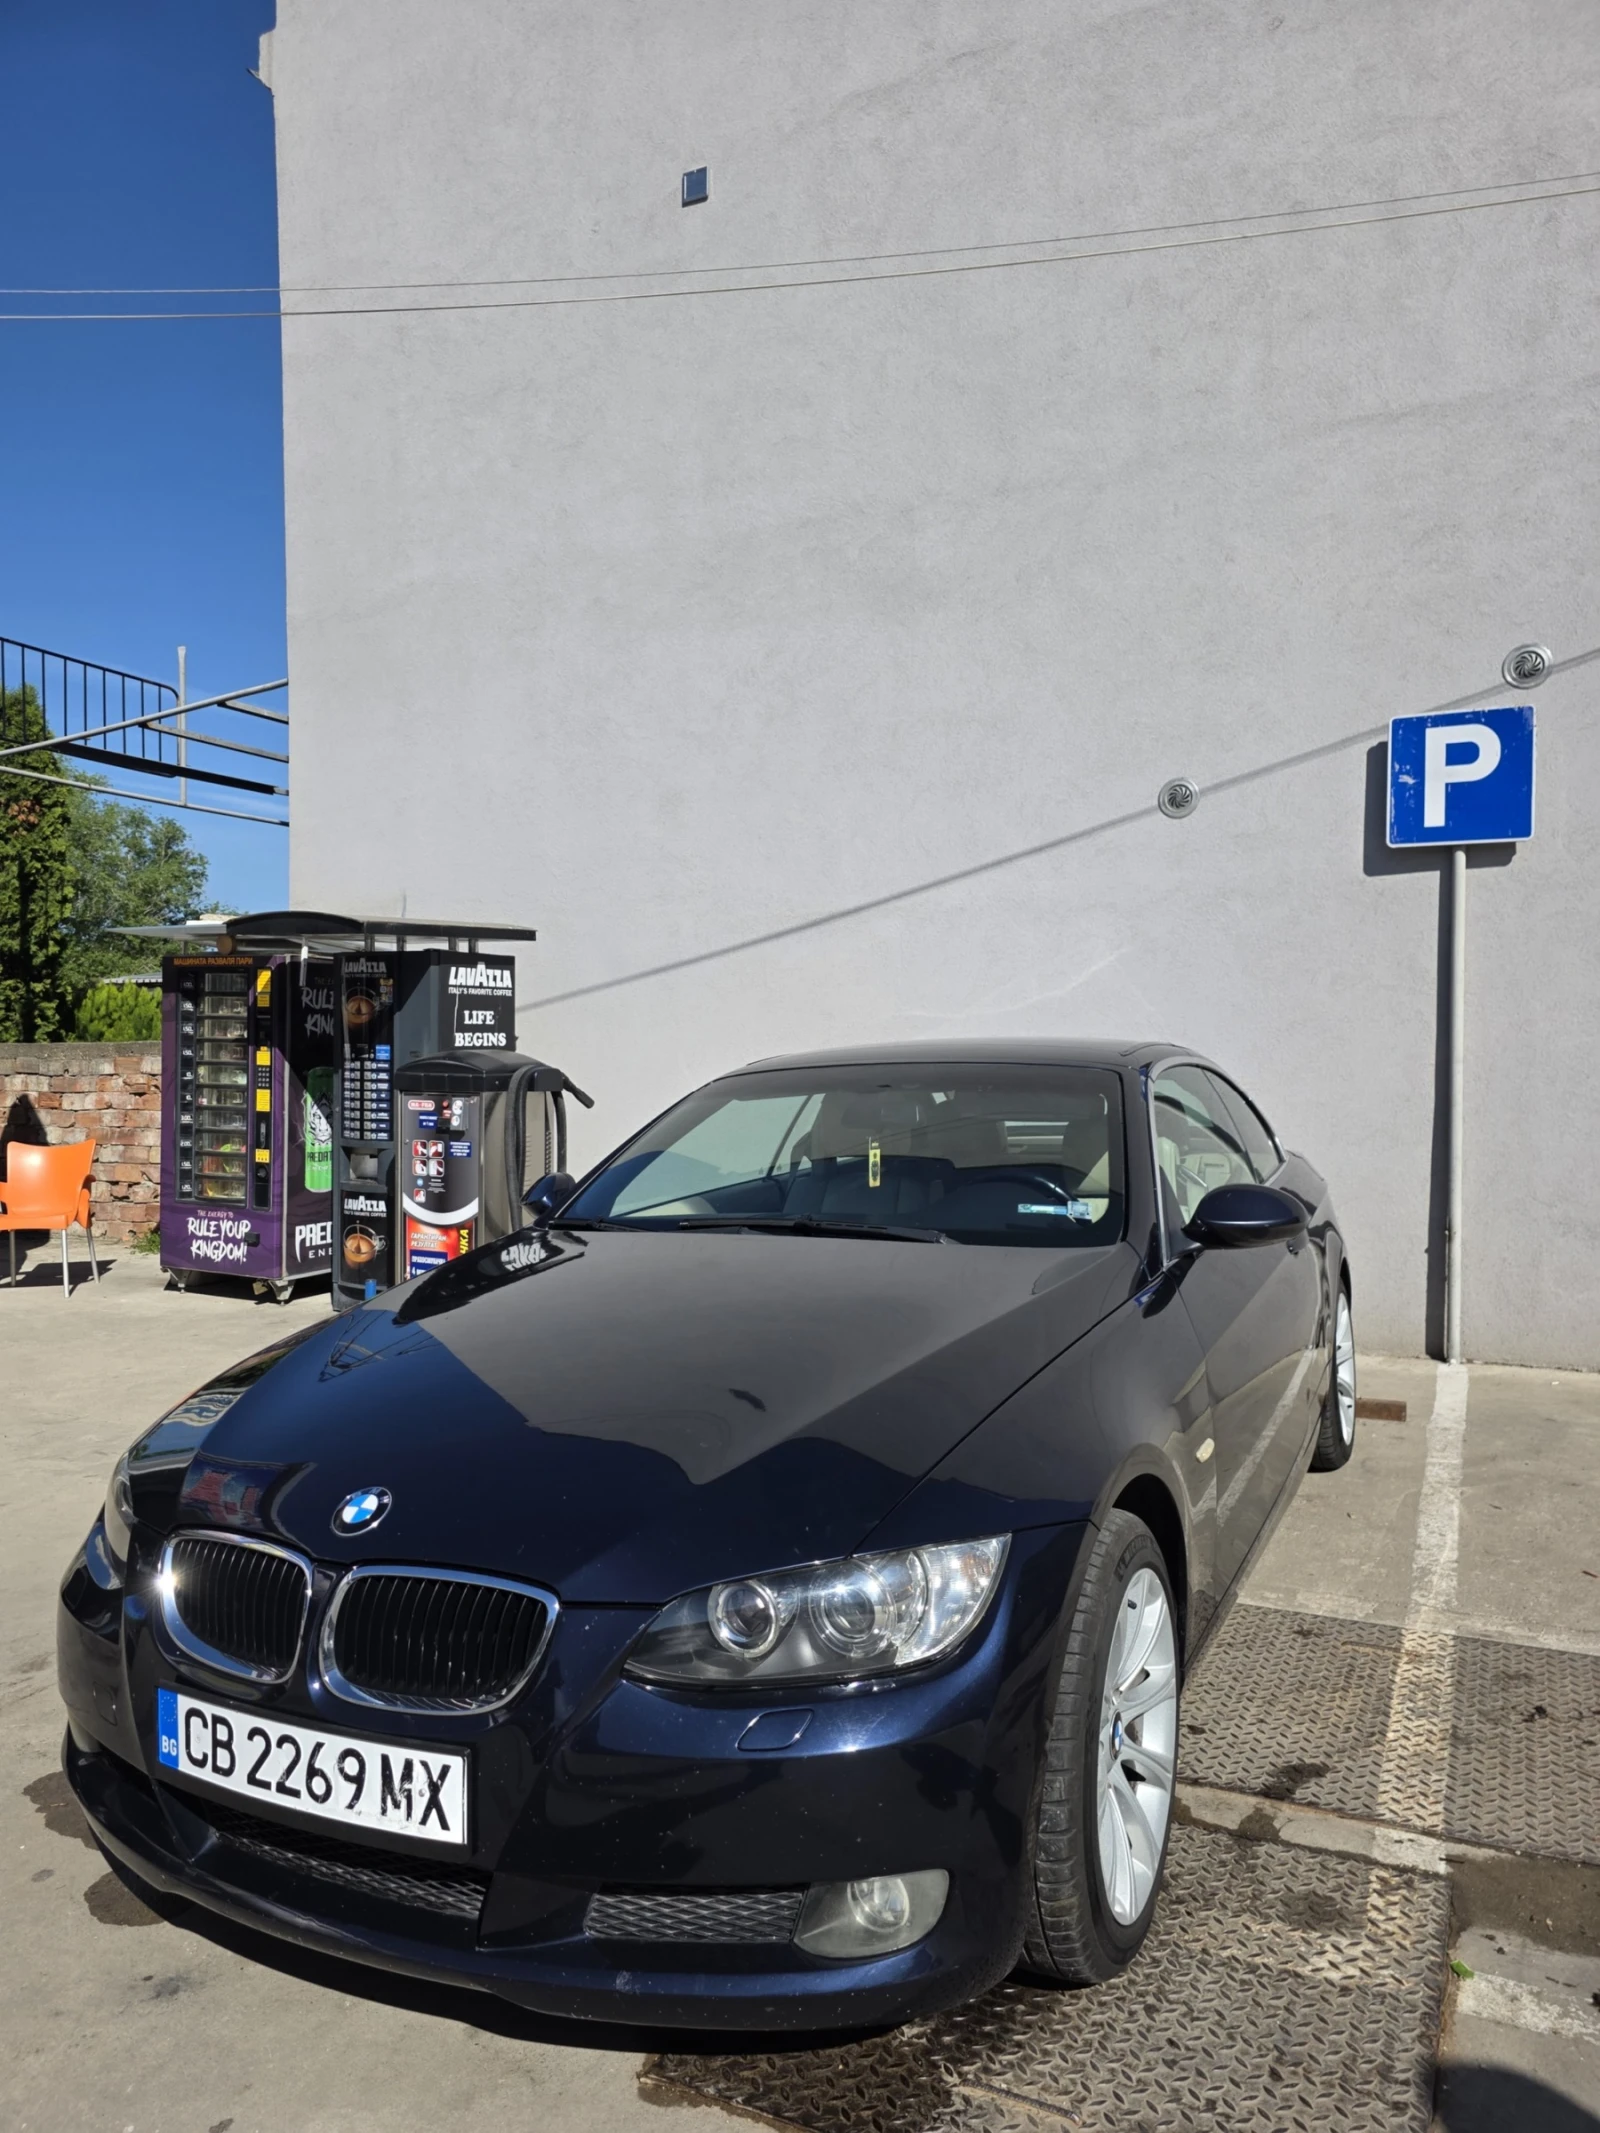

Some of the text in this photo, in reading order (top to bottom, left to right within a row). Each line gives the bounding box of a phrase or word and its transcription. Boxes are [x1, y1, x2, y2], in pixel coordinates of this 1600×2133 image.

[1423, 723, 1501, 828] P
[173, 957, 253, 966] МАШИНАТА РАЗВАЛЯ ПАРИ
[344, 957, 387, 973] LAVAZZA
[448, 962, 512, 988] LAVAZZA
[463, 1010, 495, 1025] LIFE
[454, 1032, 507, 1047] BEGINS
[343, 1195, 387, 1212] LAVAZZA
[197, 1209, 234, 1219] THE ENERGY TO
[186, 1217, 220, 1237] RULE
[190, 1238, 248, 1264] KINGDOM!
[161, 1735, 177, 1756] BG
[184, 1707, 451, 1831] CB 2269 MX
